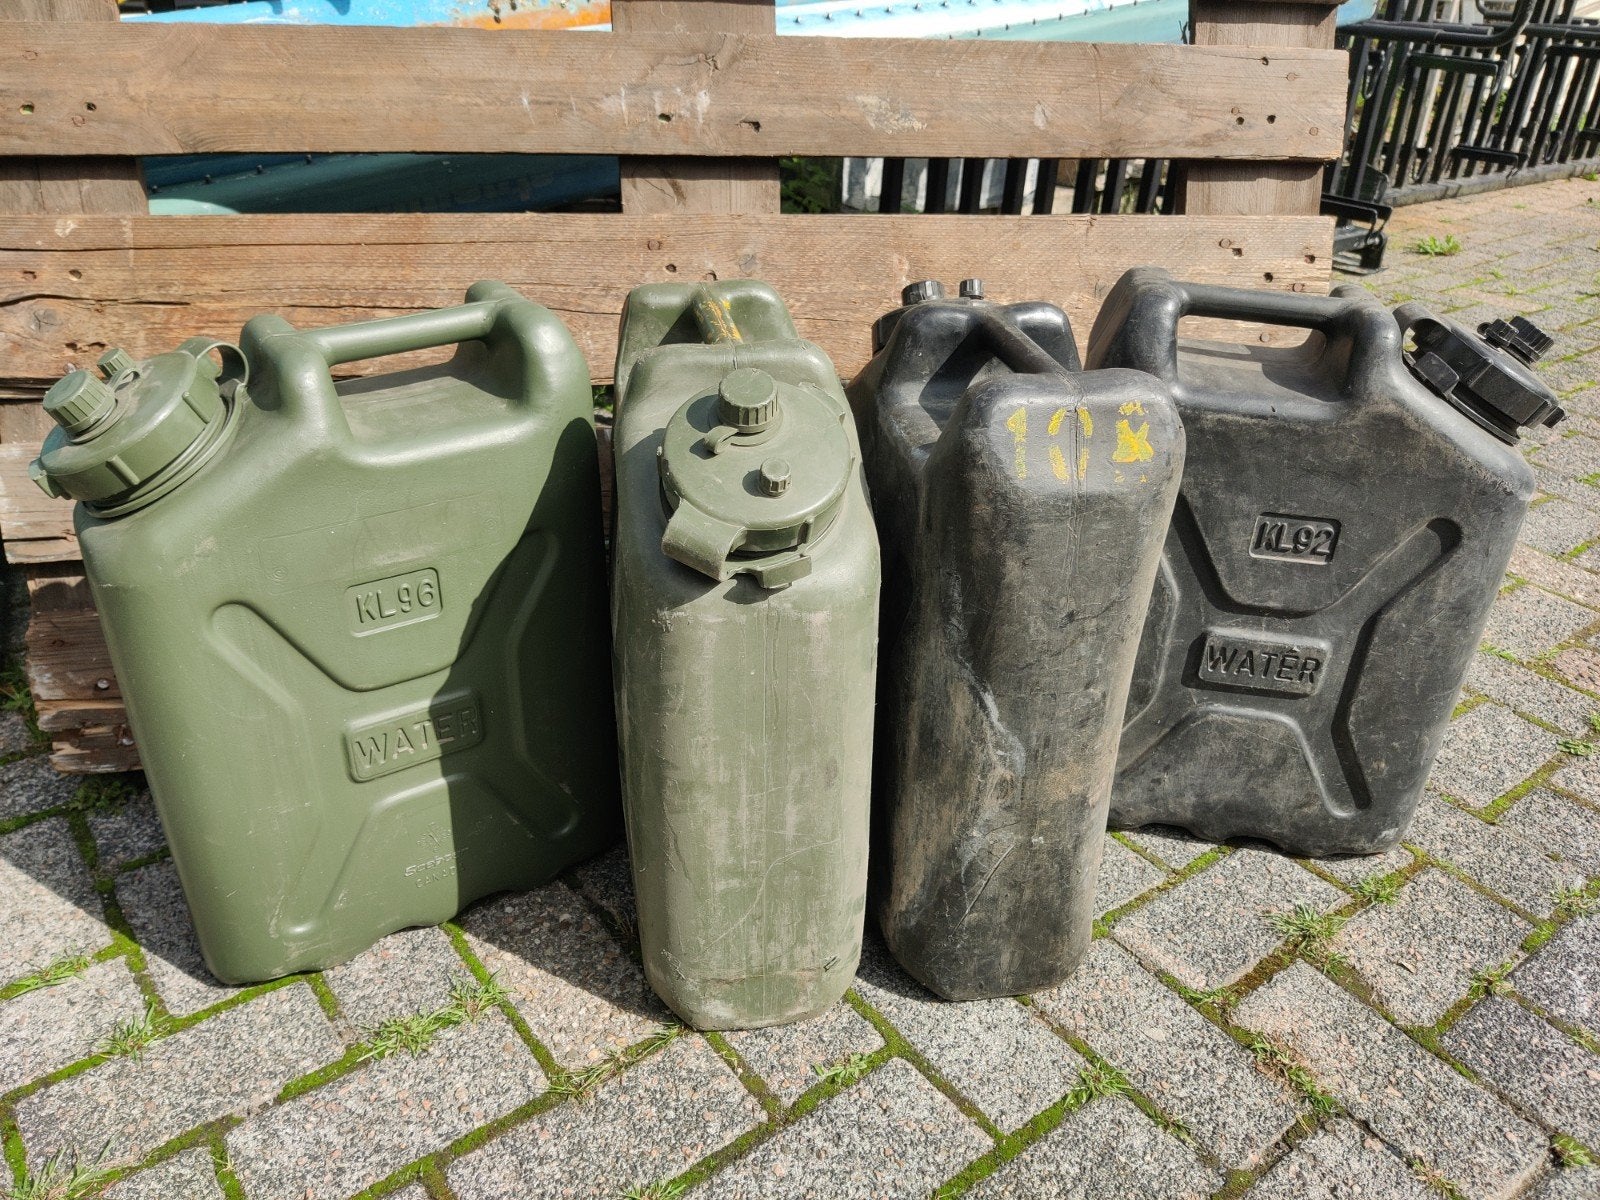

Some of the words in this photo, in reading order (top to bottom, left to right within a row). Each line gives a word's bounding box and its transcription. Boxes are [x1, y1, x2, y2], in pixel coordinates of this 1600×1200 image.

[1254, 520, 1335, 557] KL92
[355, 578, 435, 624] KL96
[1206, 644, 1323, 685] WATER
[354, 709, 478, 769] WATER
